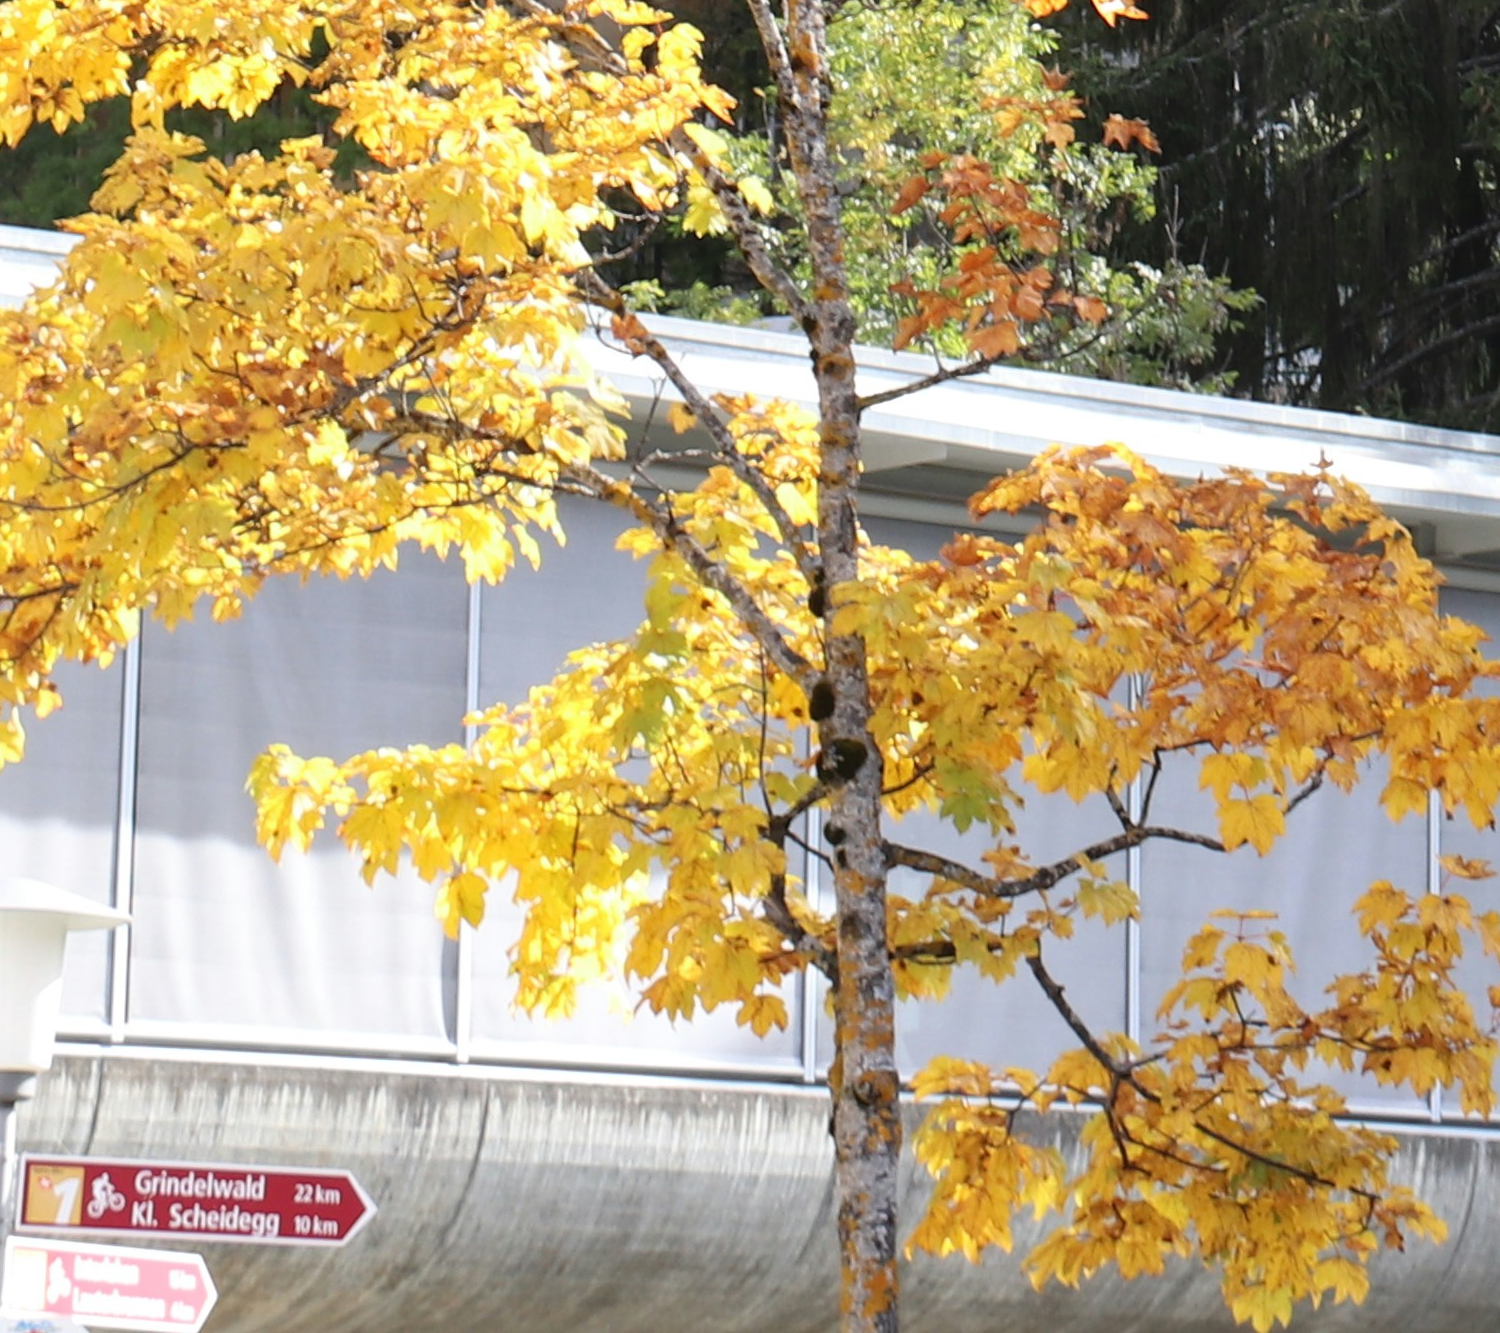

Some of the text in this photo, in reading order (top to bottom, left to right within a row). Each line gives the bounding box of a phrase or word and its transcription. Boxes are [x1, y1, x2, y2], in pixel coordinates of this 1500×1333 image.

[52, 1176, 80, 1225] 1
[134, 1169, 341, 1205] Grindelwald 22 km
[131, 1200, 339, 1236] Kl. Scheidegg 10 km
